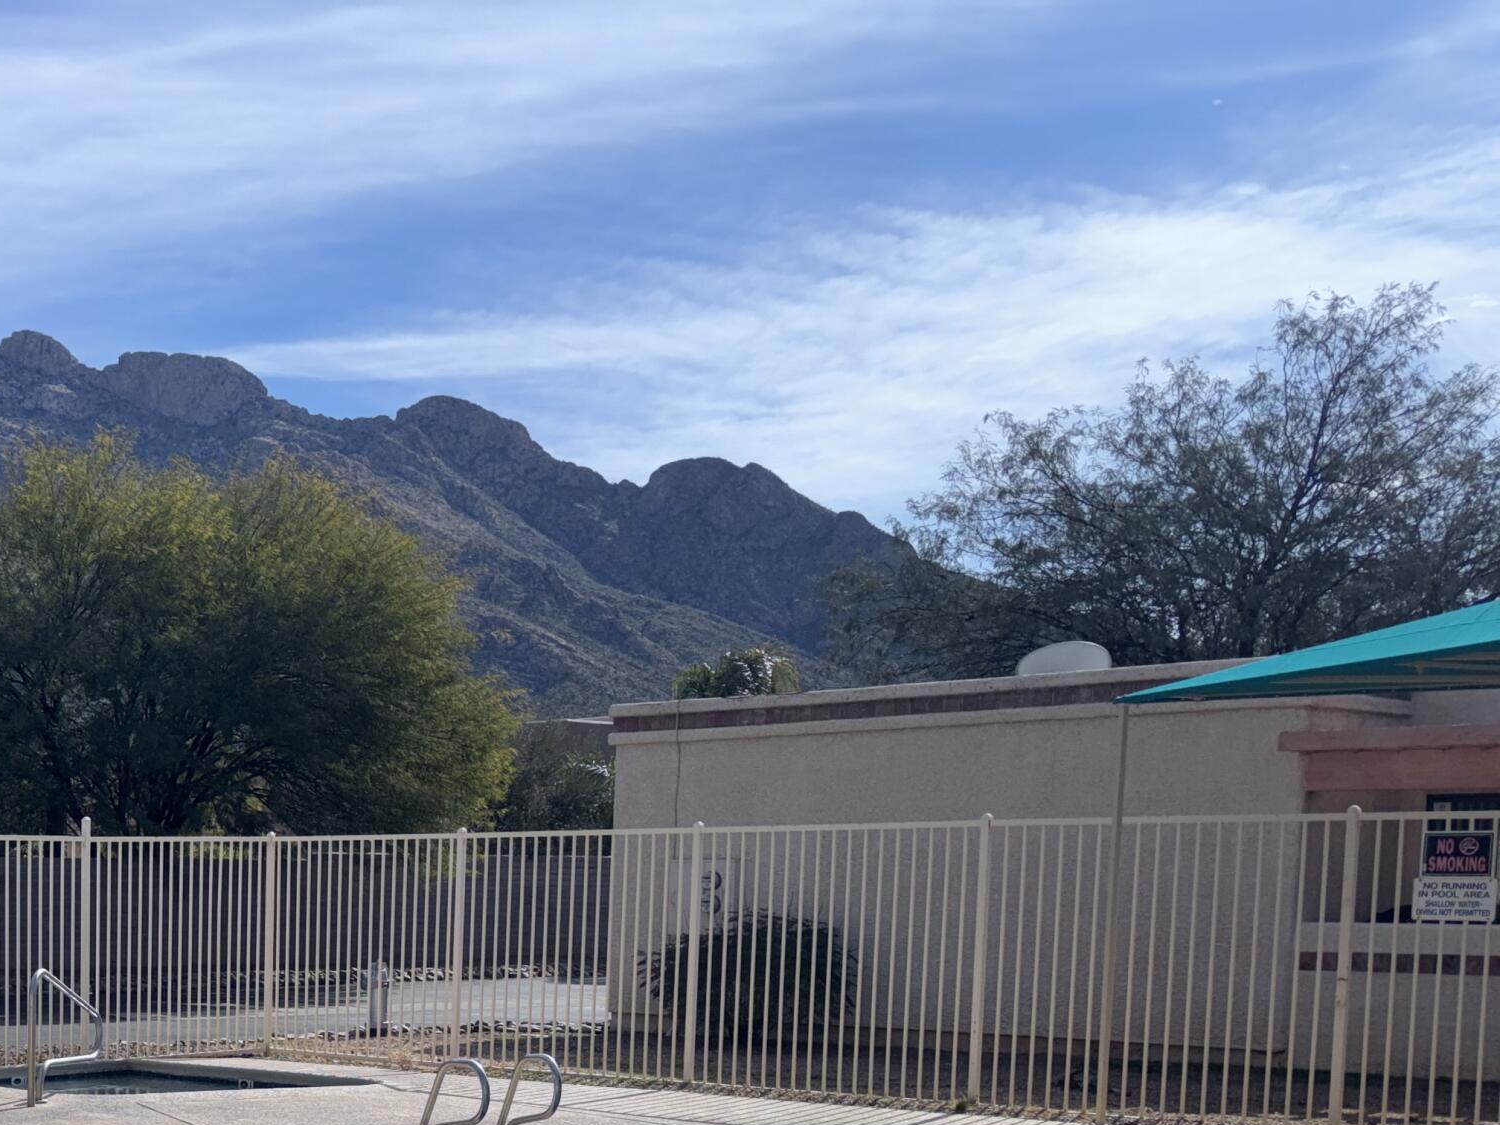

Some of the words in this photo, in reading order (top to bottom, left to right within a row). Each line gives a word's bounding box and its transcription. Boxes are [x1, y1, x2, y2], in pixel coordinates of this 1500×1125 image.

[1437, 838, 1455, 855] NO
[1428, 856, 1486, 872] SMOKING
[1441, 882, 1487, 890] RUNNING
[1425, 900, 1455, 908] SHALLOW
[1415, 909, 1437, 917] DIVING
[1439, 909, 1452, 917] NOT
[1455, 910, 1491, 918] PERMITTED
